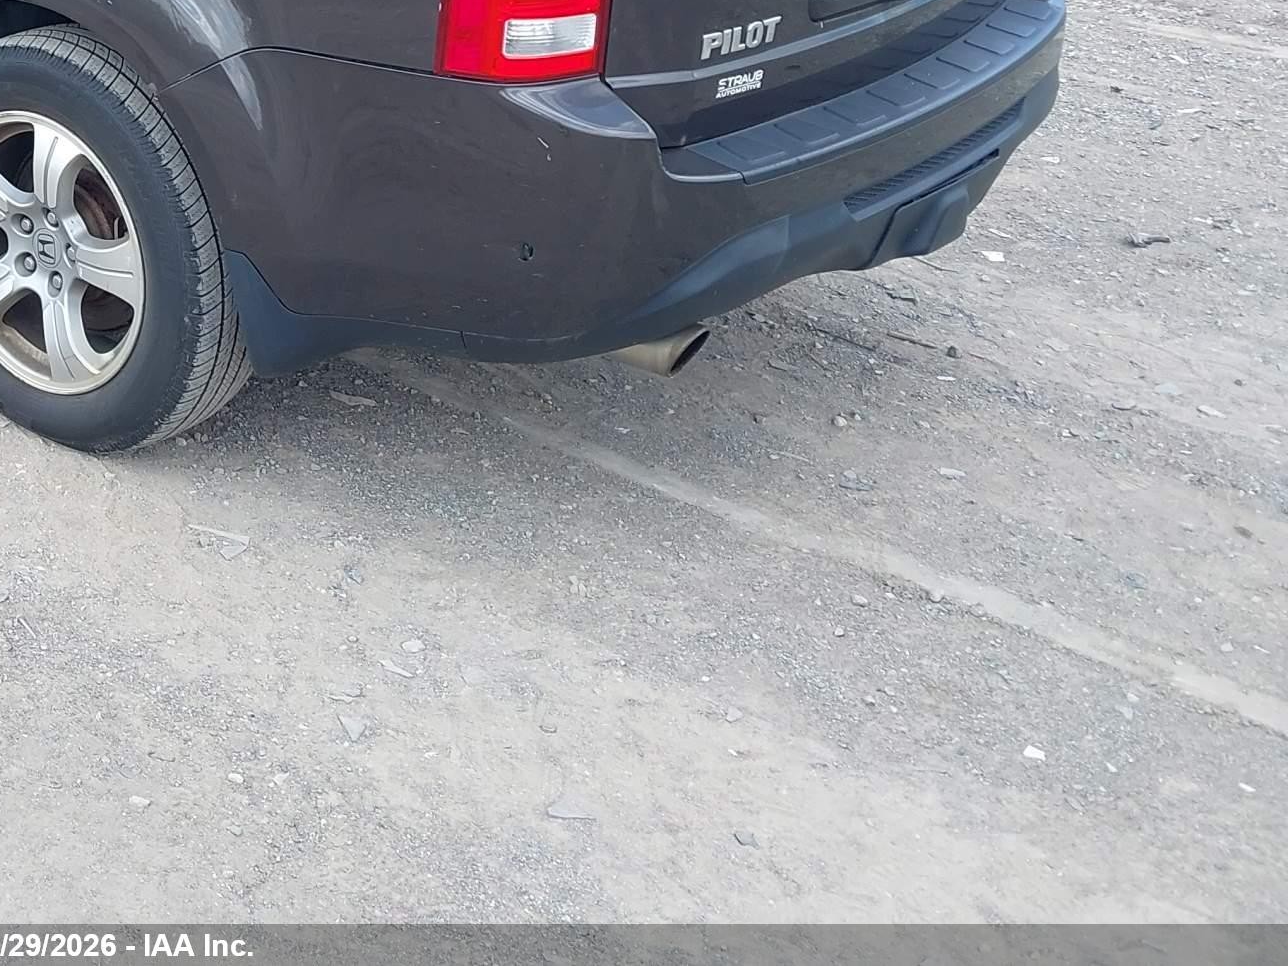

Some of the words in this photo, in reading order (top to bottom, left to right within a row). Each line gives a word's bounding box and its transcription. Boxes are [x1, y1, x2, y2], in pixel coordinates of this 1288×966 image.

[700, 15, 782, 60] PILOT
[715, 81, 762, 99] AUTOMOTIVE
[717, 69, 764, 91] STRAUB
